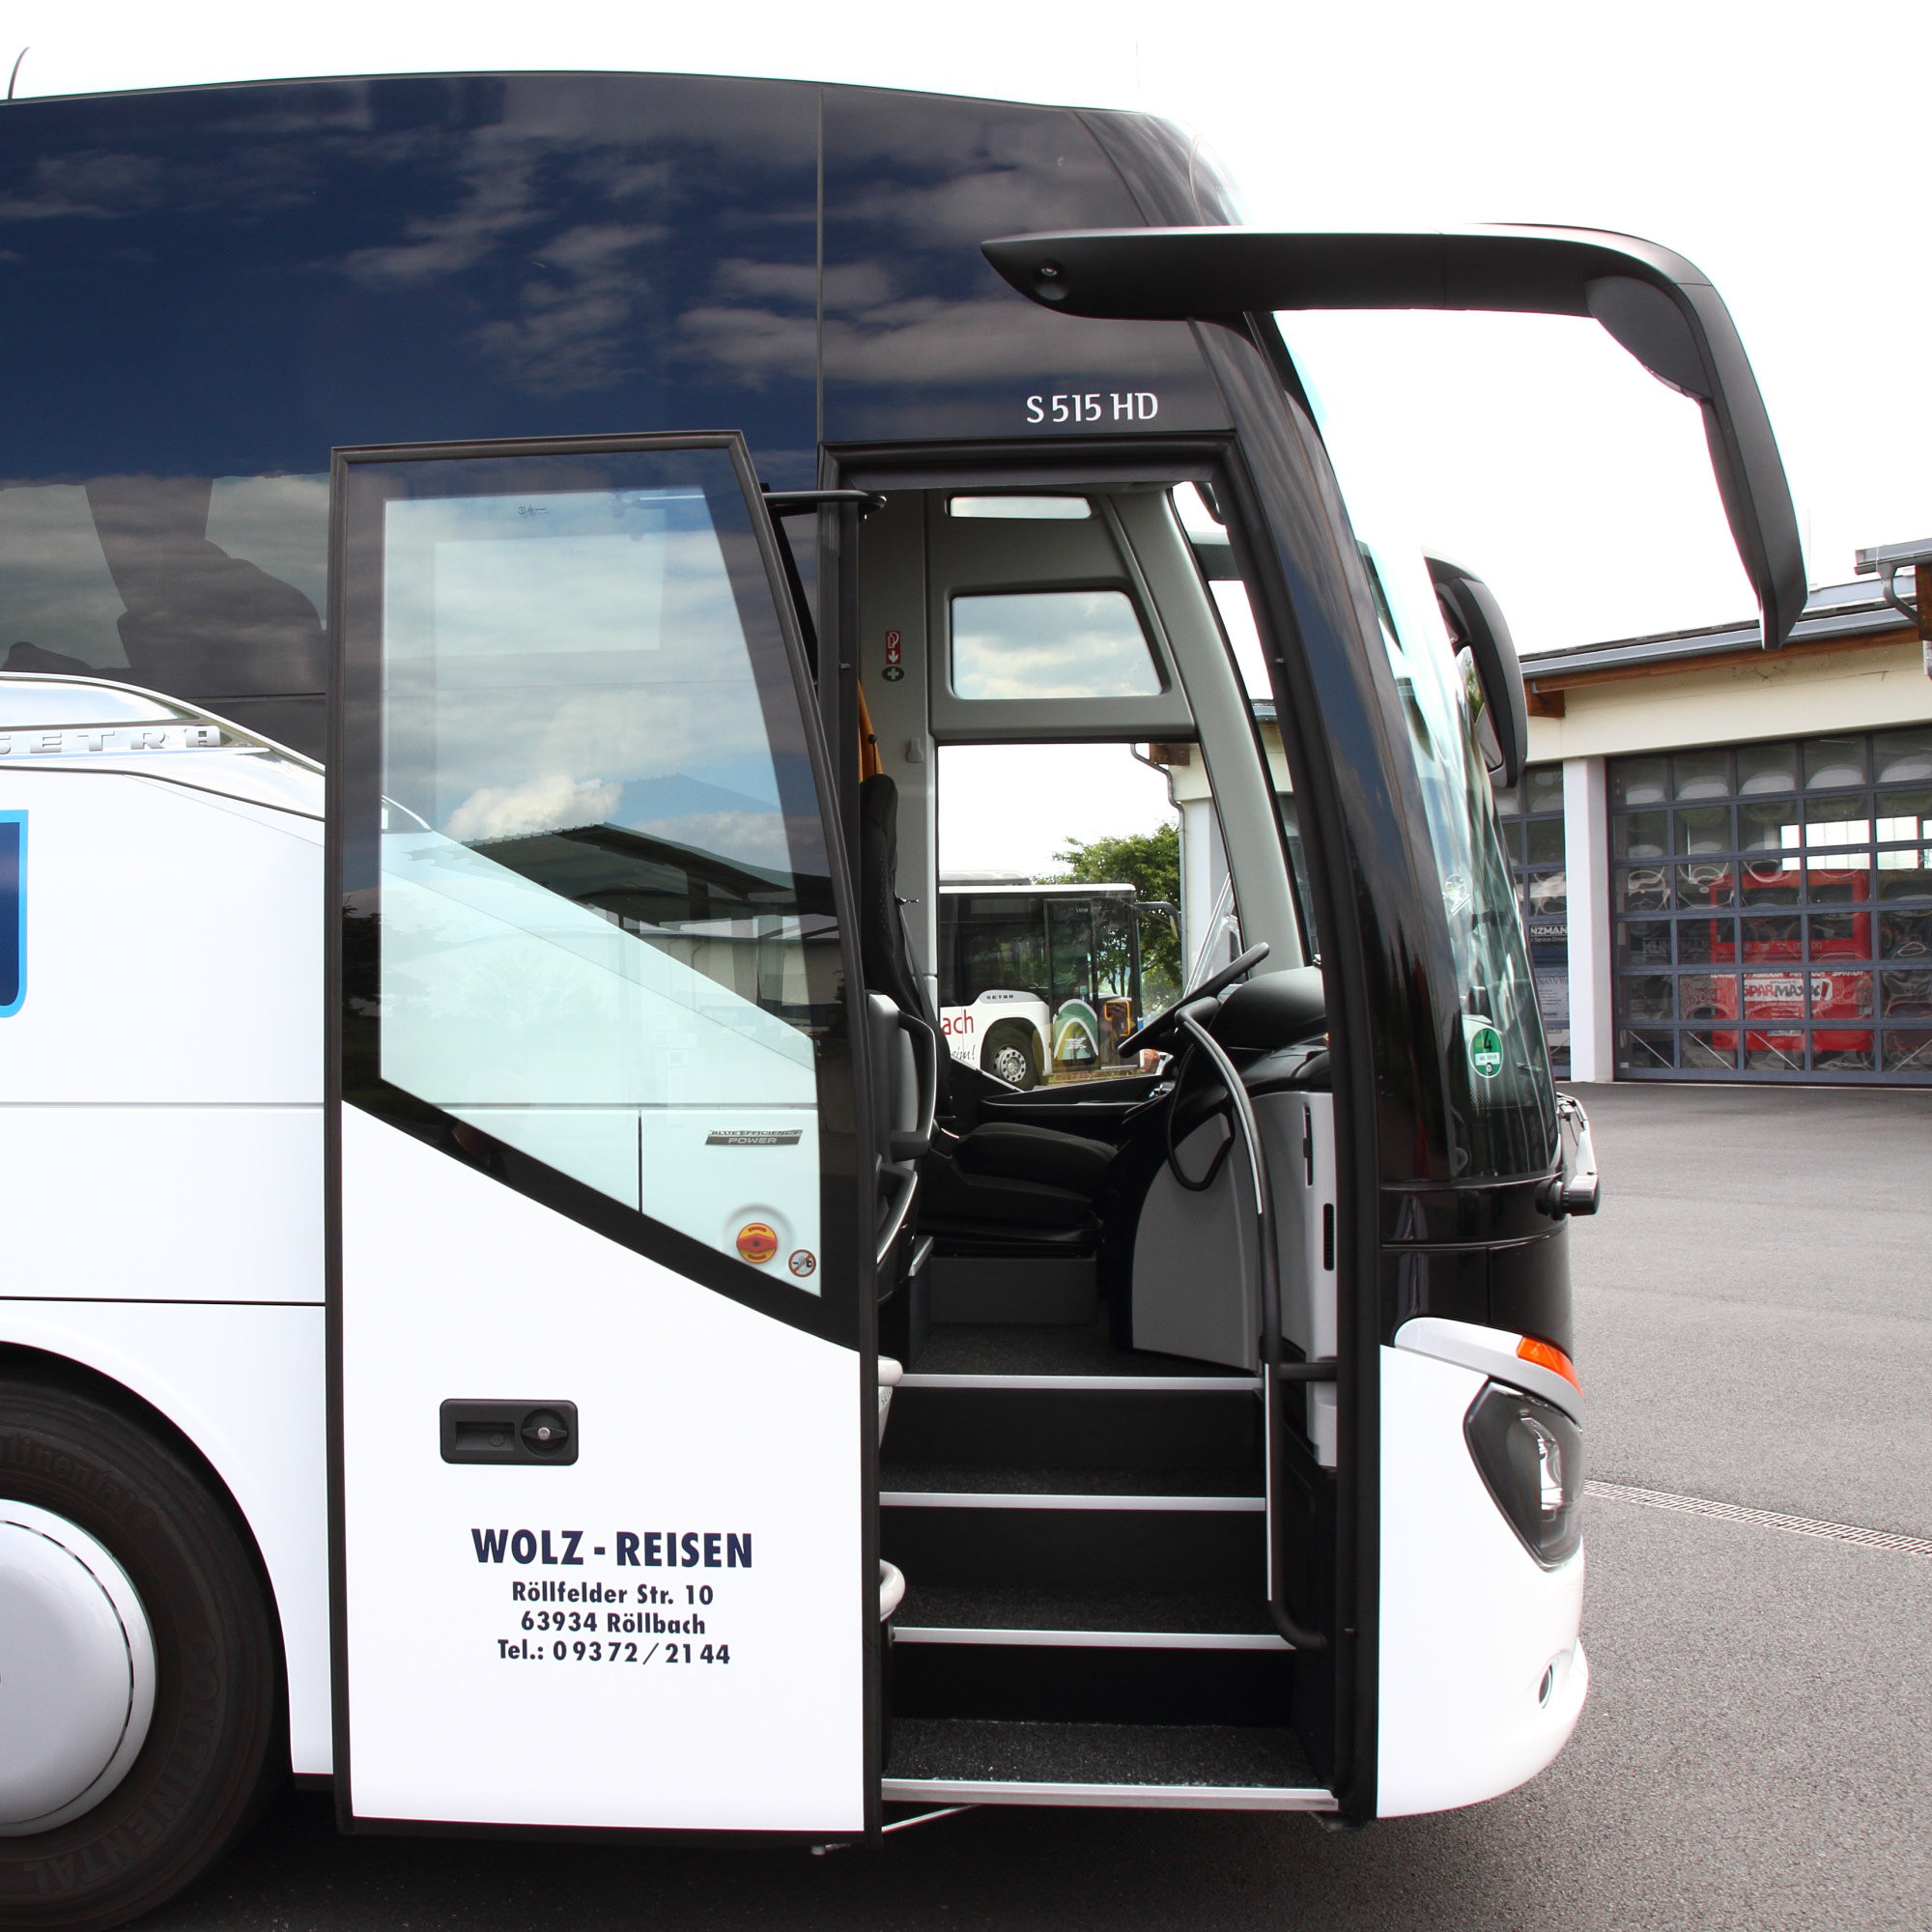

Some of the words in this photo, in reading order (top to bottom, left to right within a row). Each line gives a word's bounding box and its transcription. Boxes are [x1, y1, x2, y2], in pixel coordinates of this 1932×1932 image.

[1026, 395, 1045, 424] S
[1052, 393, 1102, 423] 515
[1110, 392, 1159, 421] HD
[1483, 1031, 1492, 1051] 4
[512, 1580, 628, 1604] Röllfelder
[637, 1583, 674, 1605] Str.
[686, 1584, 714, 1605] 10
[521, 1610, 597, 1633] 63934
[607, 1612, 706, 1634] Röllbach
[497, 1638, 544, 1660] Tel.:
